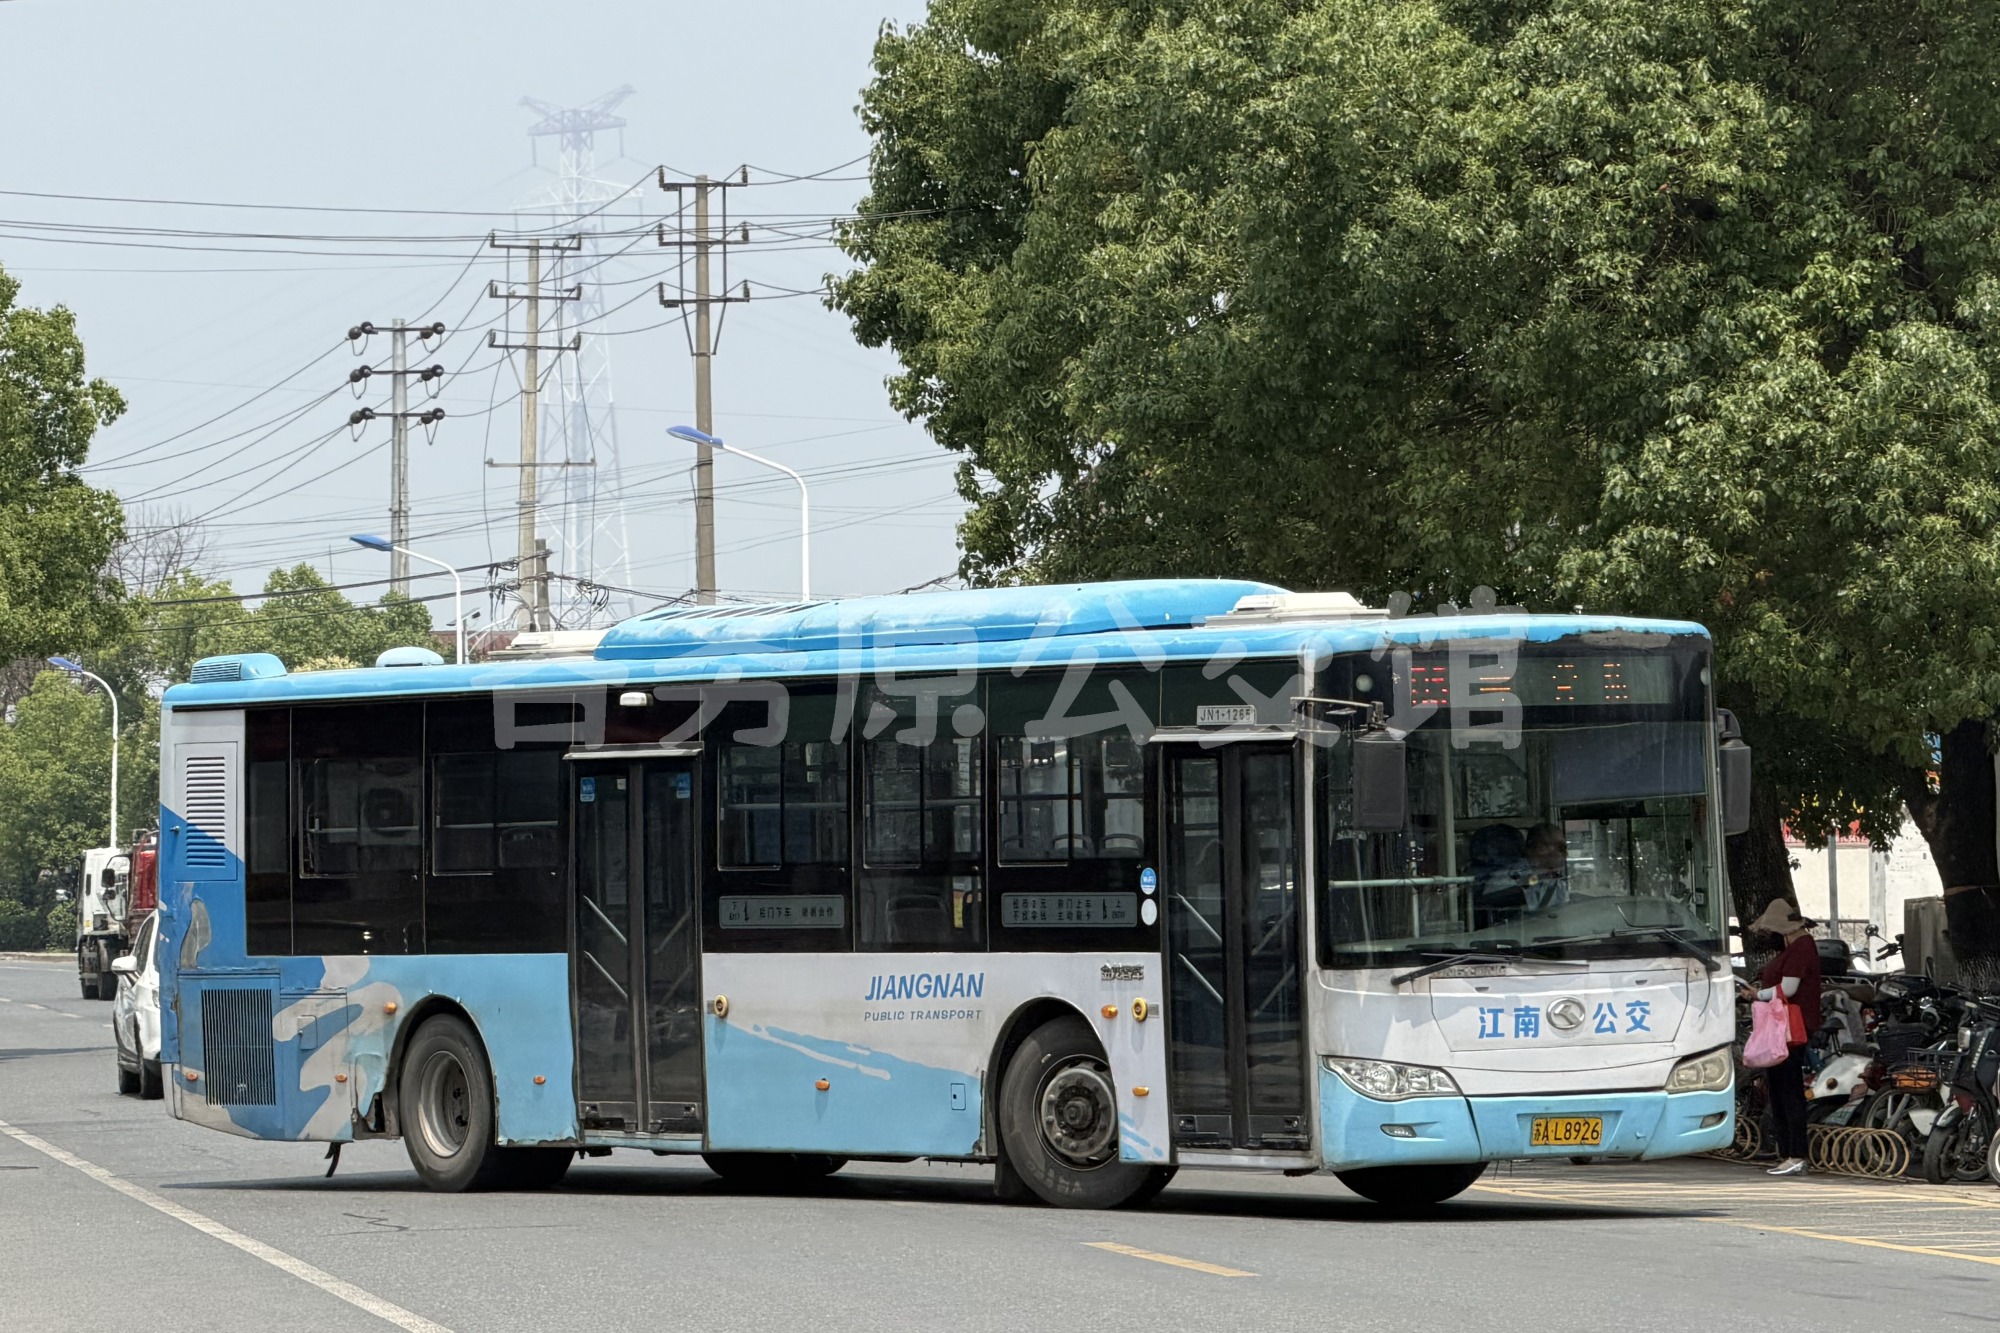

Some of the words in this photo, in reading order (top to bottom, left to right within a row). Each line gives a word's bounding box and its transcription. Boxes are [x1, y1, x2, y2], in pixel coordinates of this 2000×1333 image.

[864, 972, 984, 1001] JIANGNAN
[863, 1010, 905, 1021] PUBLIC
[910, 1008, 982, 1021] TRANSPORT
[1478, 1005, 1540, 1039] 江南
[1592, 1000, 1651, 1034] 公交
